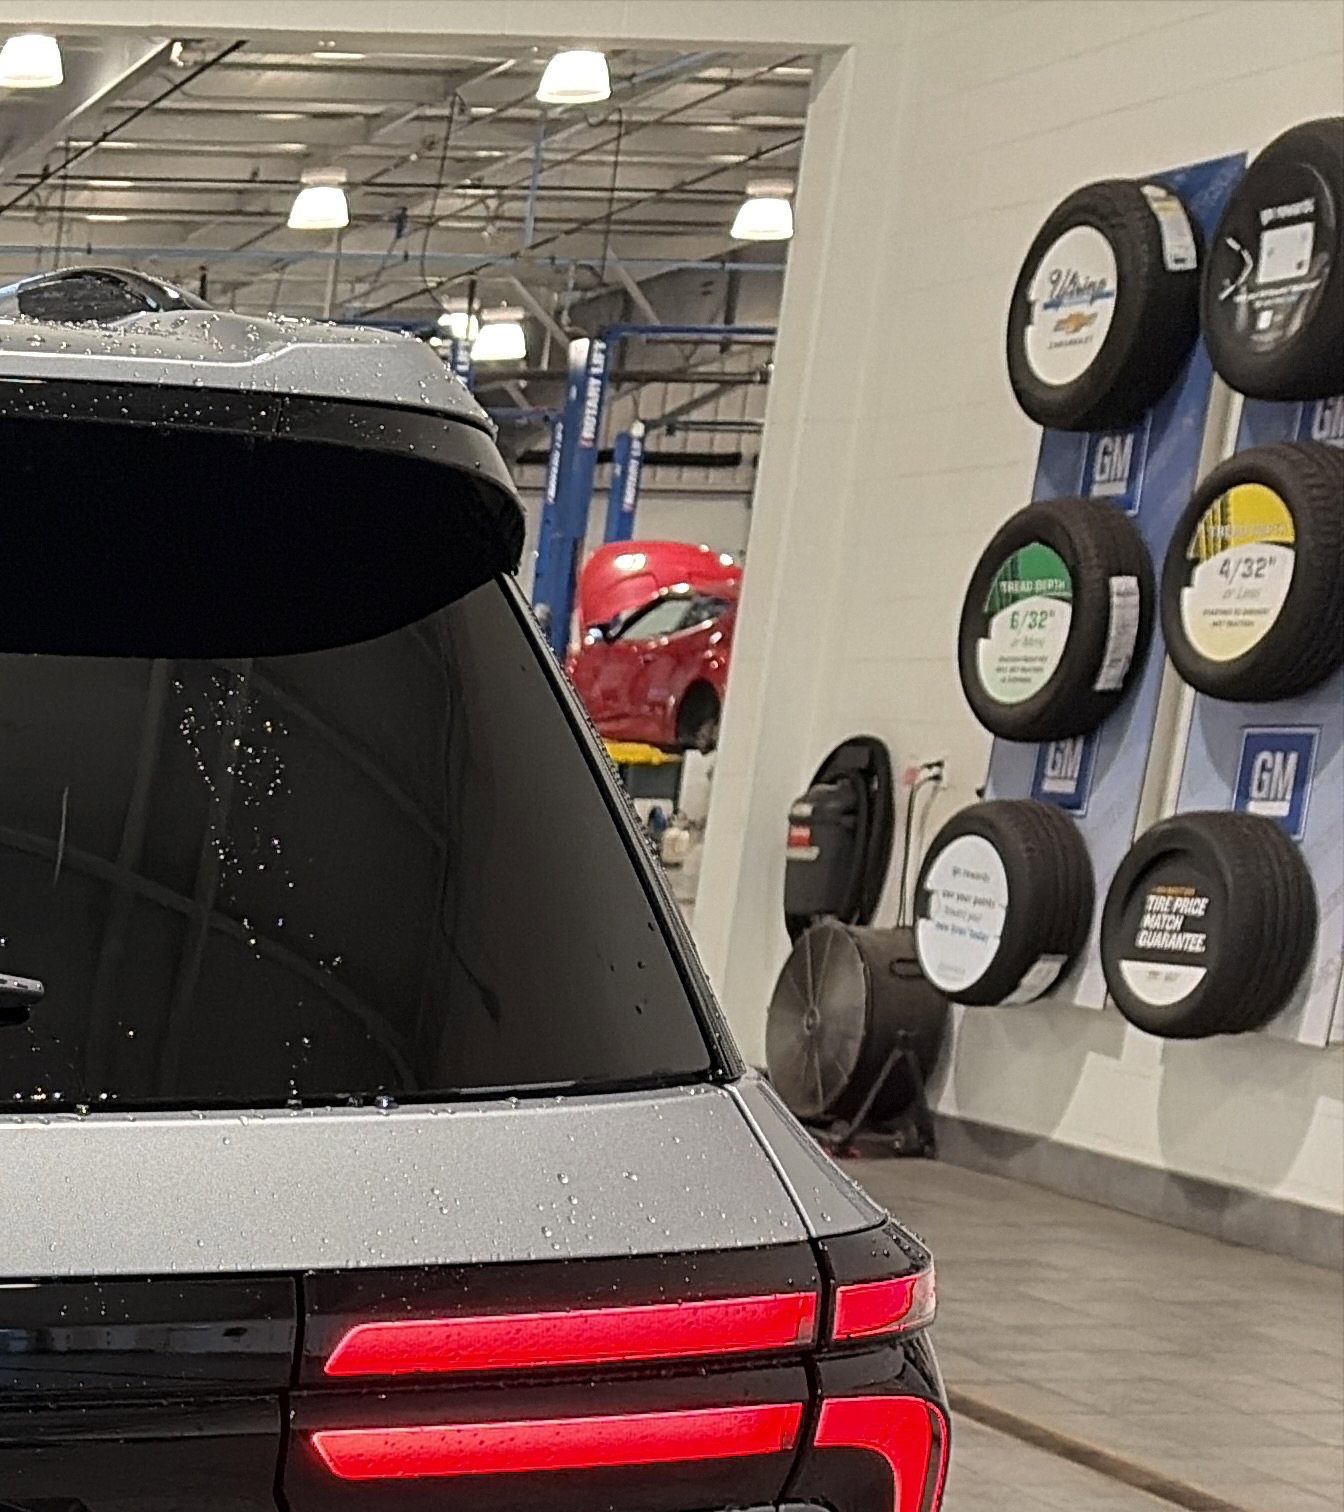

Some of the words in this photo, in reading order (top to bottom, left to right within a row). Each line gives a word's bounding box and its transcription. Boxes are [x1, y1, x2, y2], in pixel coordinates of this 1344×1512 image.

[1093, 432, 1135, 482] GM
[1046, 737, 1084, 779] GM
[1249, 750, 1299, 801] GM
[1140, 912, 1185, 931] MATCH
[1145, 894, 1173, 912] TIRE
[1173, 896, 1210, 917] PRICE
